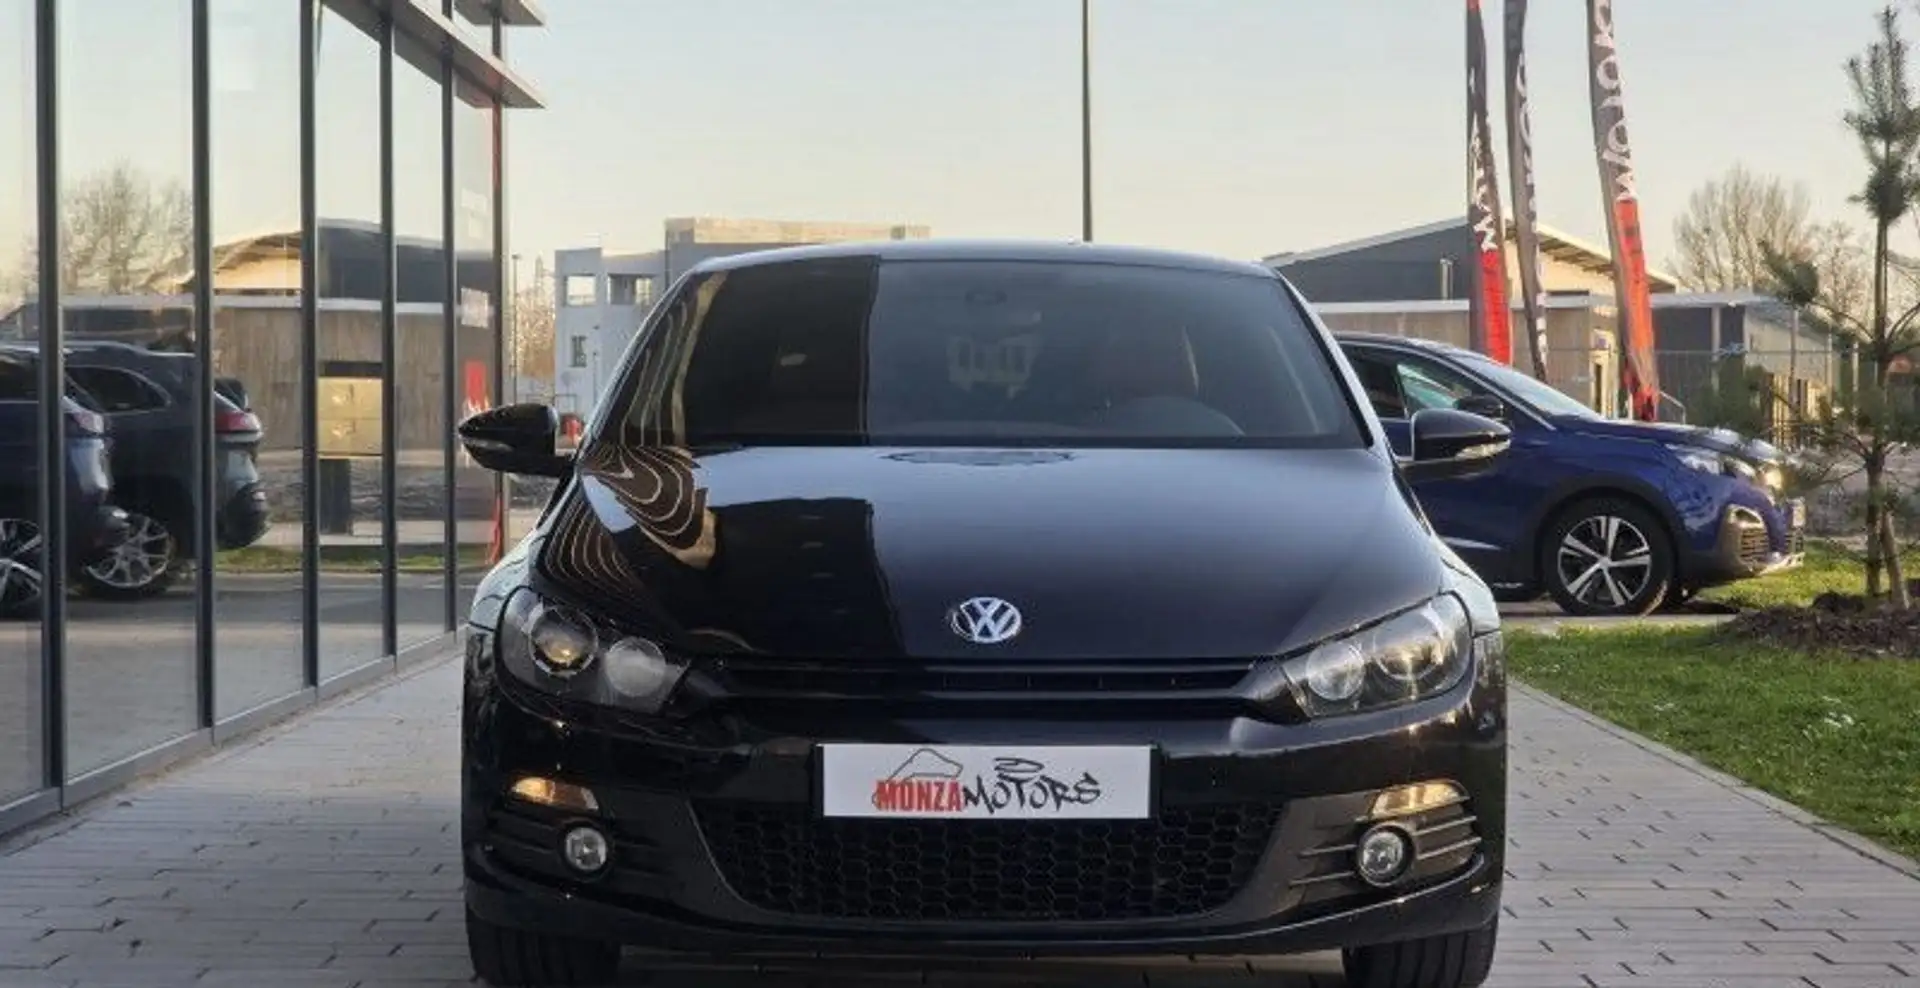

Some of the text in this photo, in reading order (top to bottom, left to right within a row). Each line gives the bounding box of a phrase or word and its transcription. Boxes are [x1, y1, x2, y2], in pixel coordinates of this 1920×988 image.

[952, 597, 1022, 643] VW
[876, 772, 1101, 814] MONZA MOTORS
